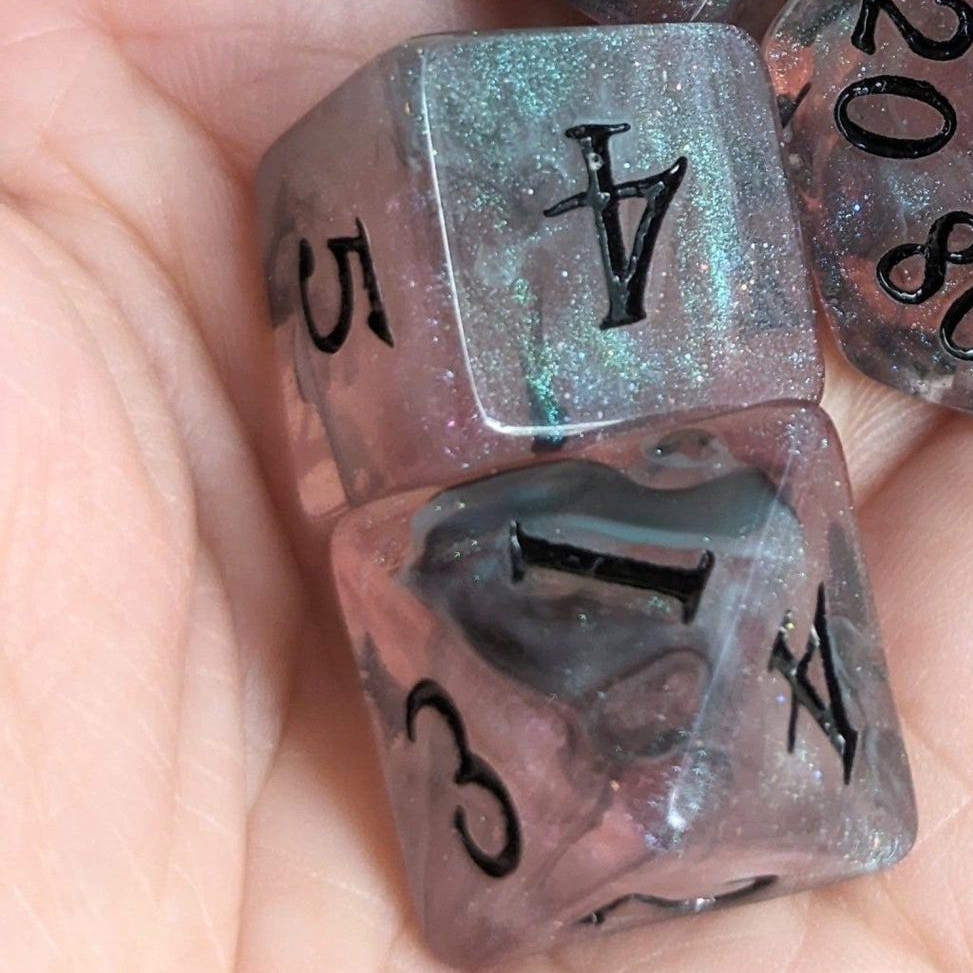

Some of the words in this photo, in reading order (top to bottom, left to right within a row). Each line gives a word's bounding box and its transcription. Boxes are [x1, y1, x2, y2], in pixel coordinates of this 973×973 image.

[299, 216, 394, 353] 5
[543, 123, 687, 328] 4
[508, 520, 716, 625] 1
[405, 678, 522, 878] 3
[768, 581, 858, 785] 4
